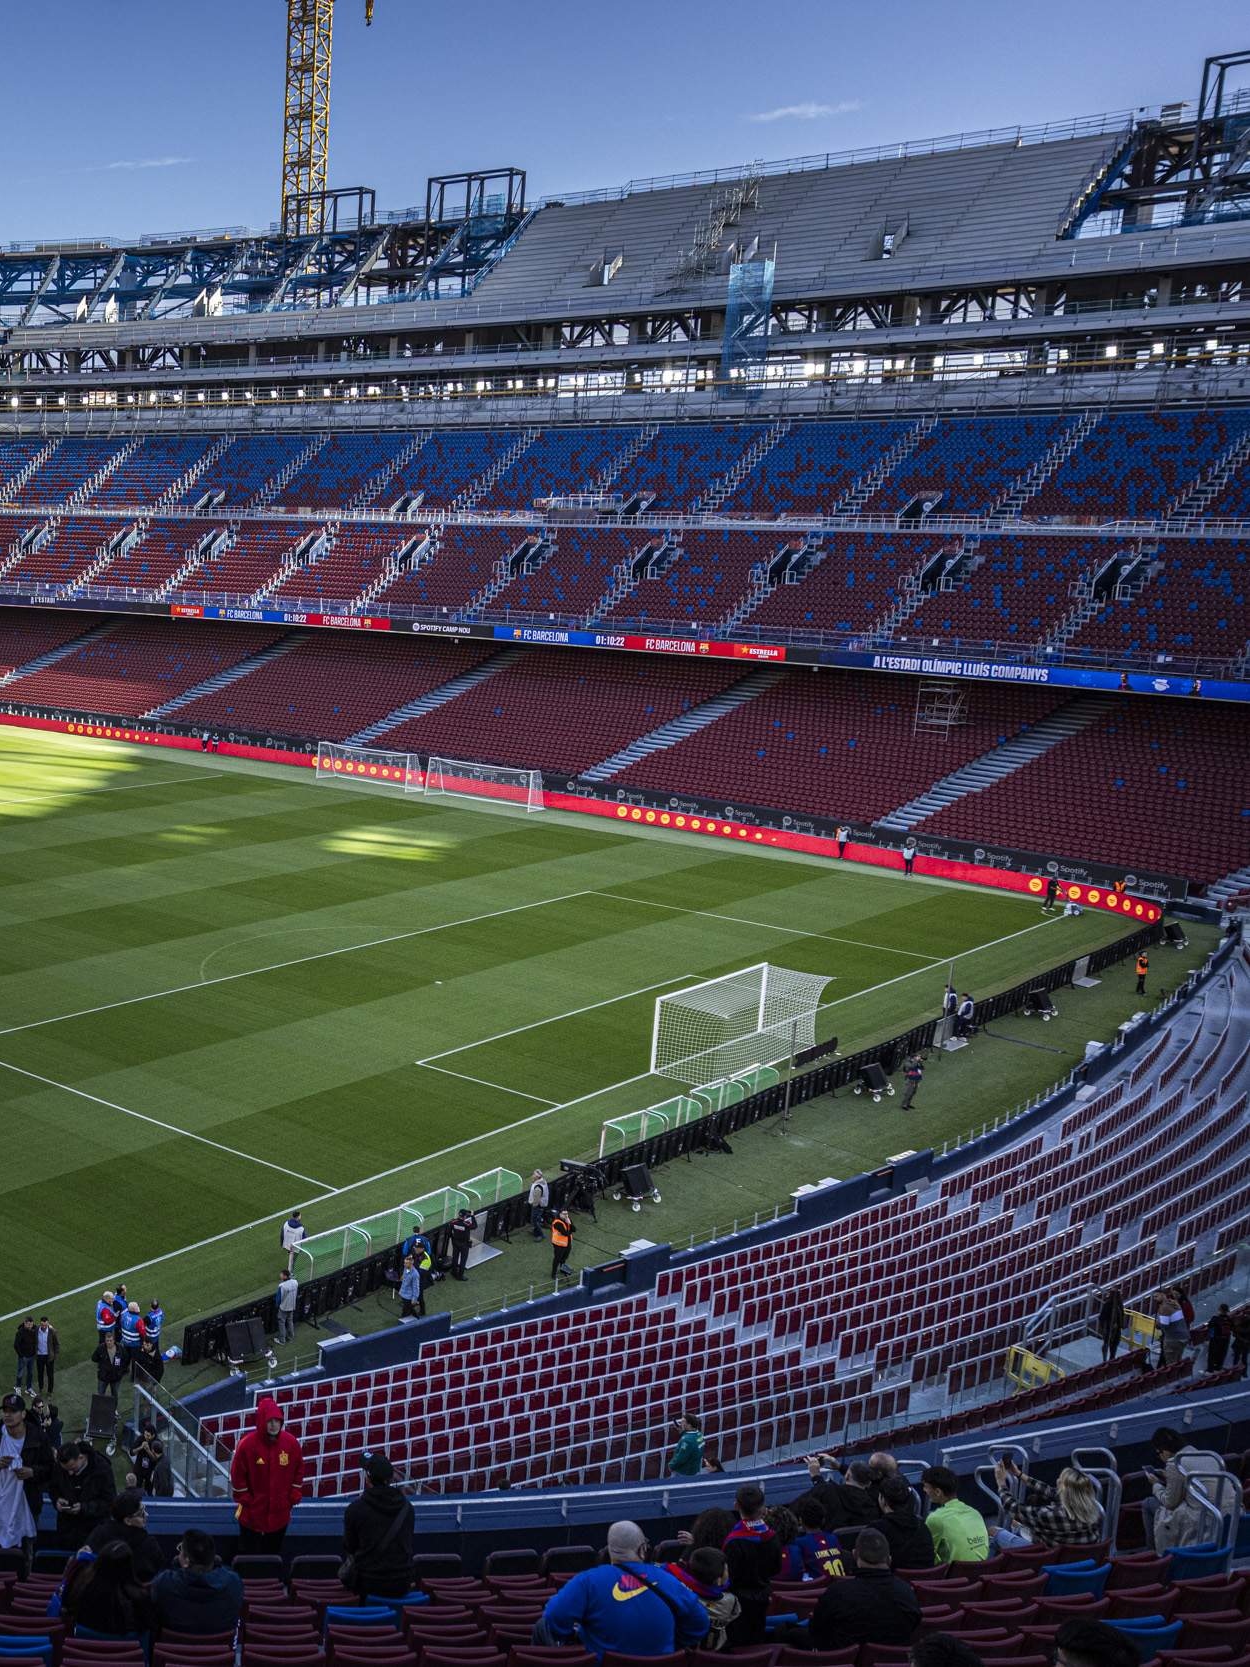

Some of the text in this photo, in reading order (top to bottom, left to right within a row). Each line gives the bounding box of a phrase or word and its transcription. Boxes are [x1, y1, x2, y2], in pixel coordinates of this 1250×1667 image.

[227, 610, 263, 620] FC BARCELONA
[322, 615, 361, 627] FC BARCELONA
[420, 624, 442, 632] SPOTIFY
[442, 625, 458, 633] CAMP
[523, 630, 569, 643] FC BARCELONA
[595, 635, 625, 647] 01:10:22
[645, 638, 696, 653] FC BARCELONA
[749, 648, 778, 657] ESTRELLA
[873, 655, 1048, 682] A L'ESTADI OLÍMPIC LLUÍS COMPANYS
[853, 829, 876, 839] Spotify
[918, 840, 942, 851] Spotify
[986, 852, 1013, 863] Spotify
[1059, 865, 1088, 876] Spotify
[1138, 878, 1169, 890] Spotify
[822, 1558, 846, 1577] 10
